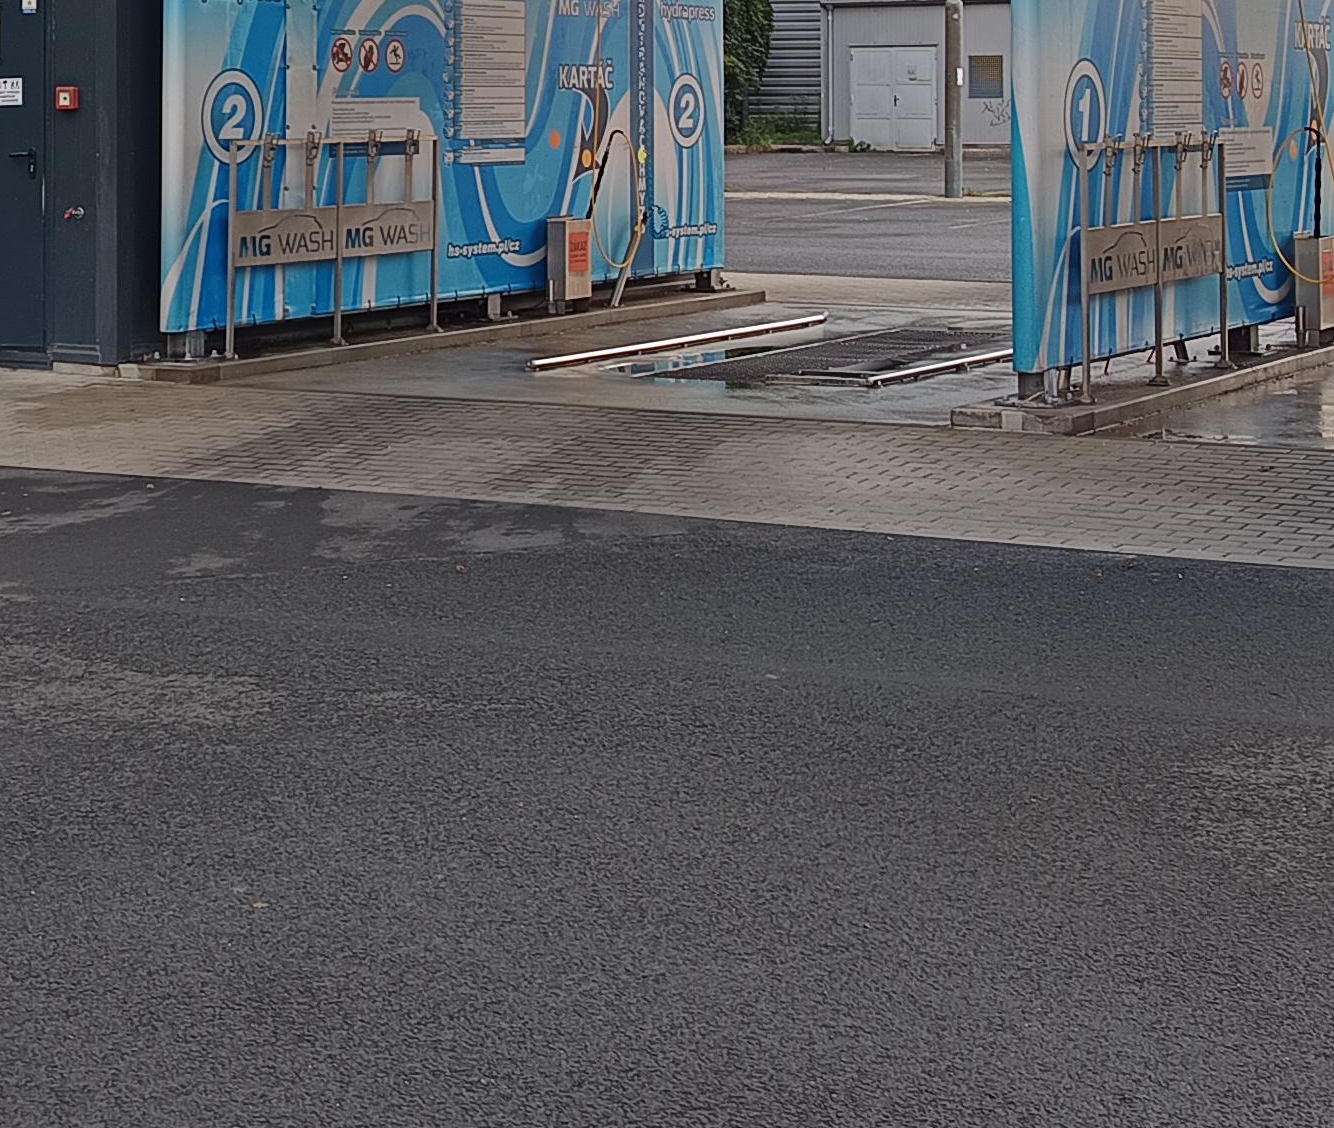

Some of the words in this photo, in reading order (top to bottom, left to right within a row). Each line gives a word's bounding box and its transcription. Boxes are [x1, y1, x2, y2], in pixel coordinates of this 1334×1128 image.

[559, 58, 614, 89] KARTÁČ
[218, 94, 248, 140] 2
[678, 92, 696, 129] 2
[1078, 88, 1091, 142] 1
[239, 234, 272, 258] MG
[278, 230, 335, 255] WASH
[344, 226, 374, 249] MG
[379, 222, 432, 245] WASH
[1090, 257, 1113, 284] MG
[1117, 250, 1156, 278] WASH
[1162, 245, 1183, 271] MG
